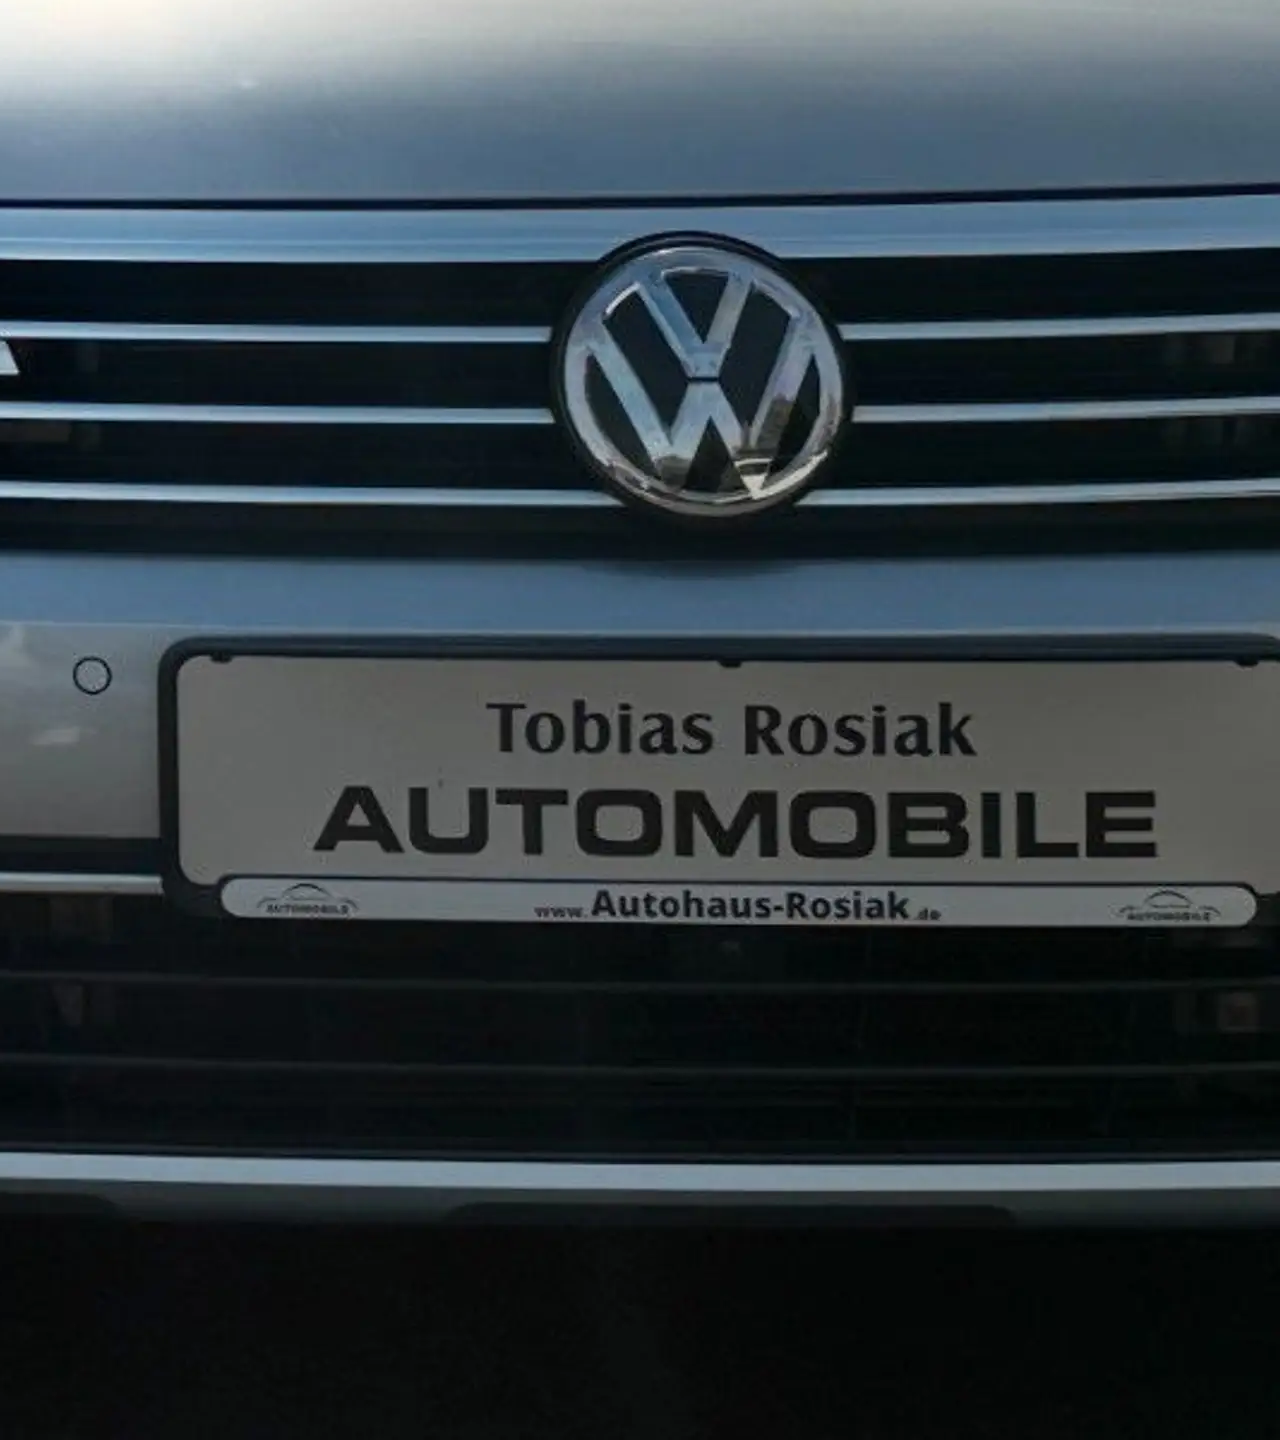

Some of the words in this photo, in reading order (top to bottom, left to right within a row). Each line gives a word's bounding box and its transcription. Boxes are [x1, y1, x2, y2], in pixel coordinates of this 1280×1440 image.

[486, 699, 713, 755] Tobias
[744, 702, 978, 757] Rosiak
[313, 785, 1157, 859] AUTOMOBILE
